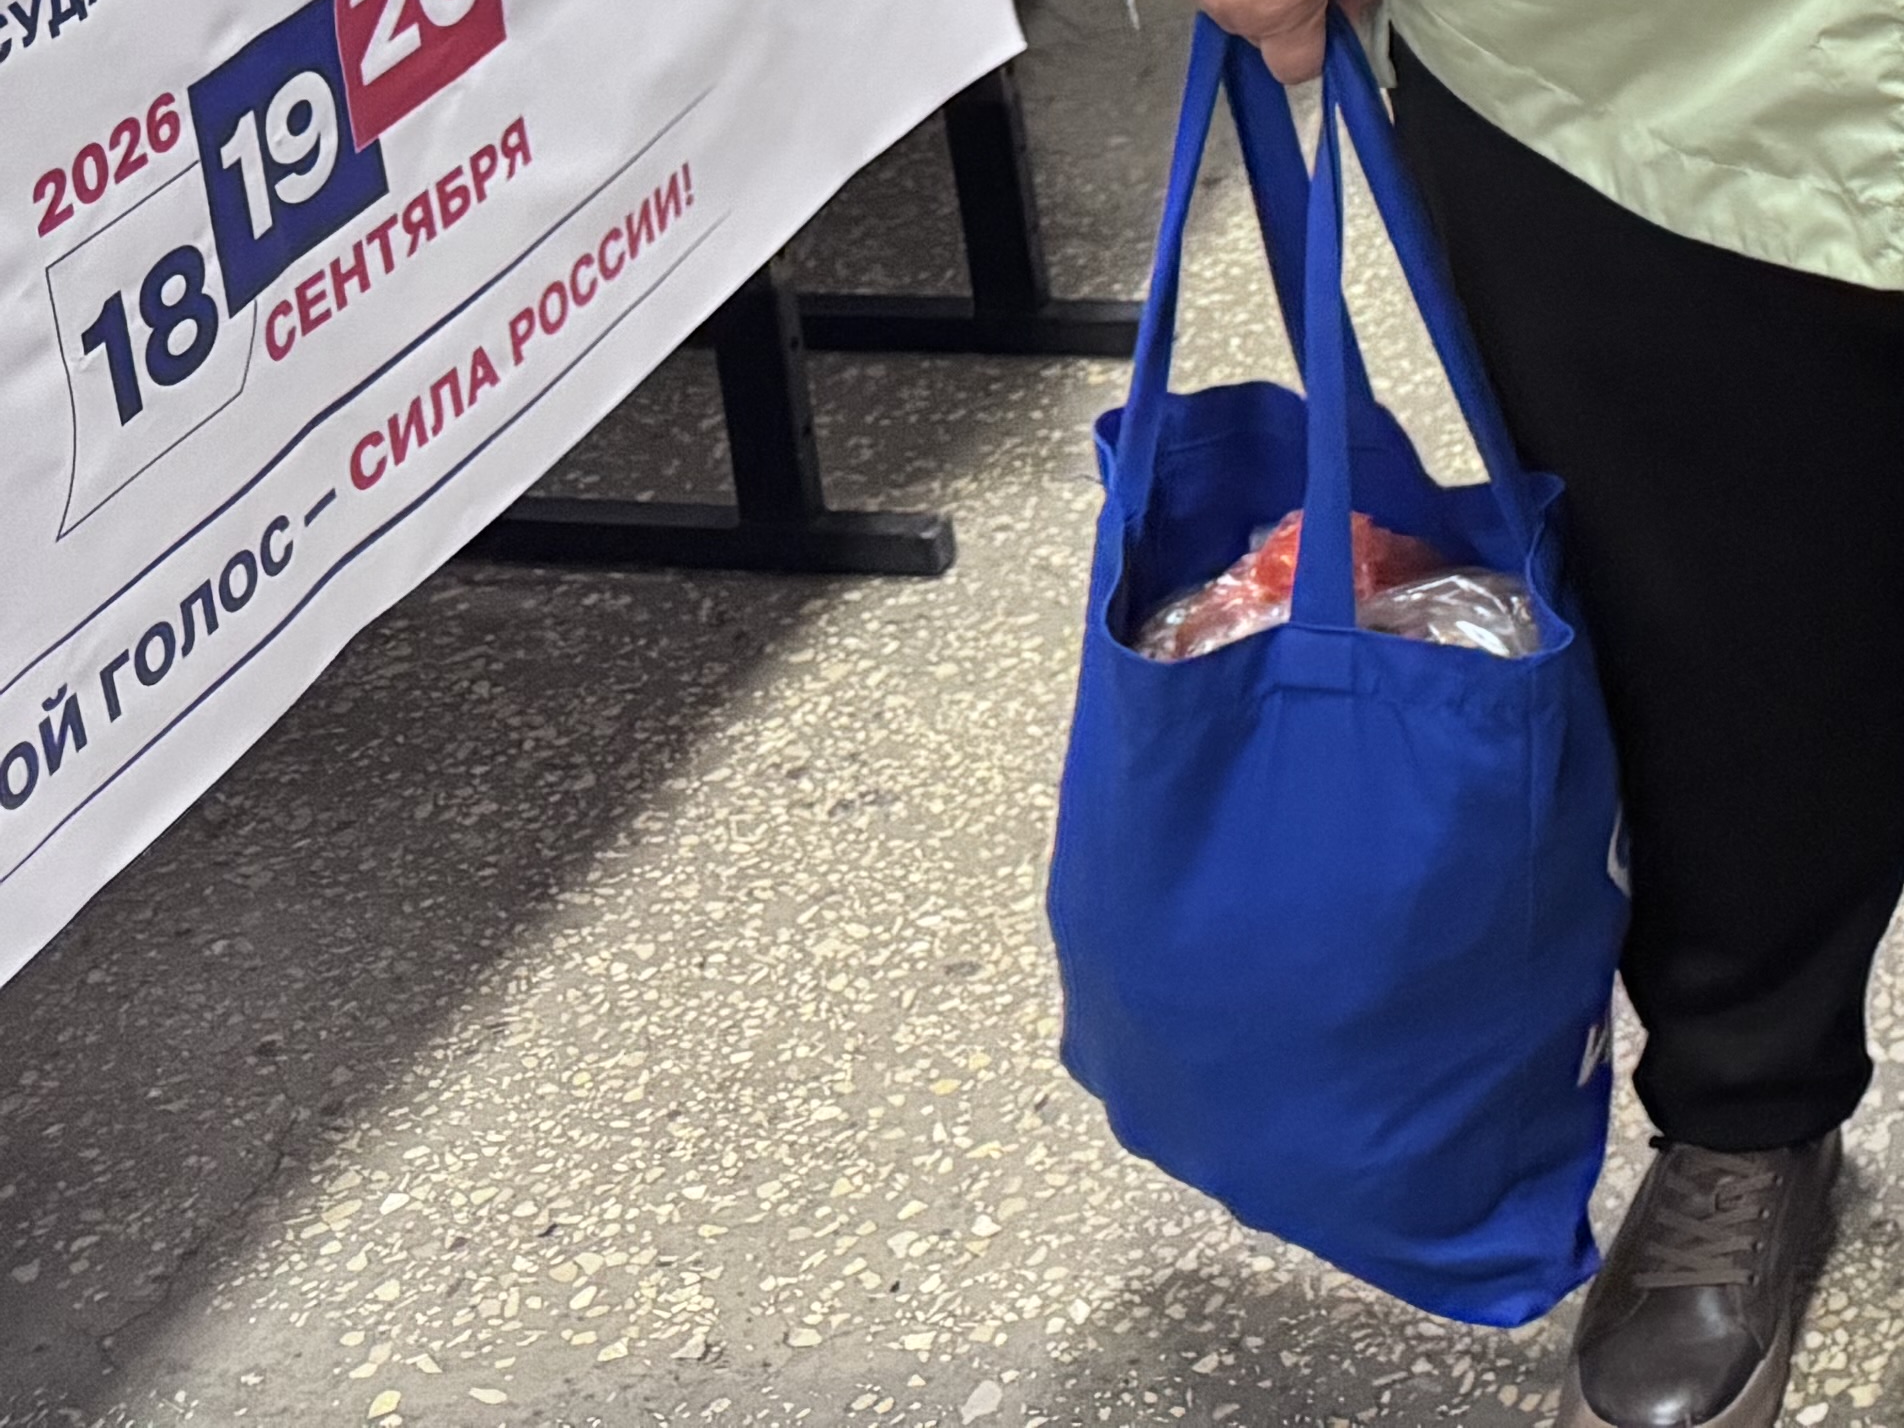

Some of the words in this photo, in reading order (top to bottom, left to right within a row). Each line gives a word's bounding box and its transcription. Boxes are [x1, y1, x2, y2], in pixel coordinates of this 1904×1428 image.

[30, 92, 183, 237] 2026
[217, 69, 342, 243] 19
[266, 115, 534, 362] СЕНТЯБРЯ
[83, 243, 221, 425] 18
[0, 682, 88, 810] ОЙ
[100, 512, 295, 723] ГОЛОС
[348, 348, 501, 493] СИЛА
[509, 163, 697, 368] РОССИИ!
